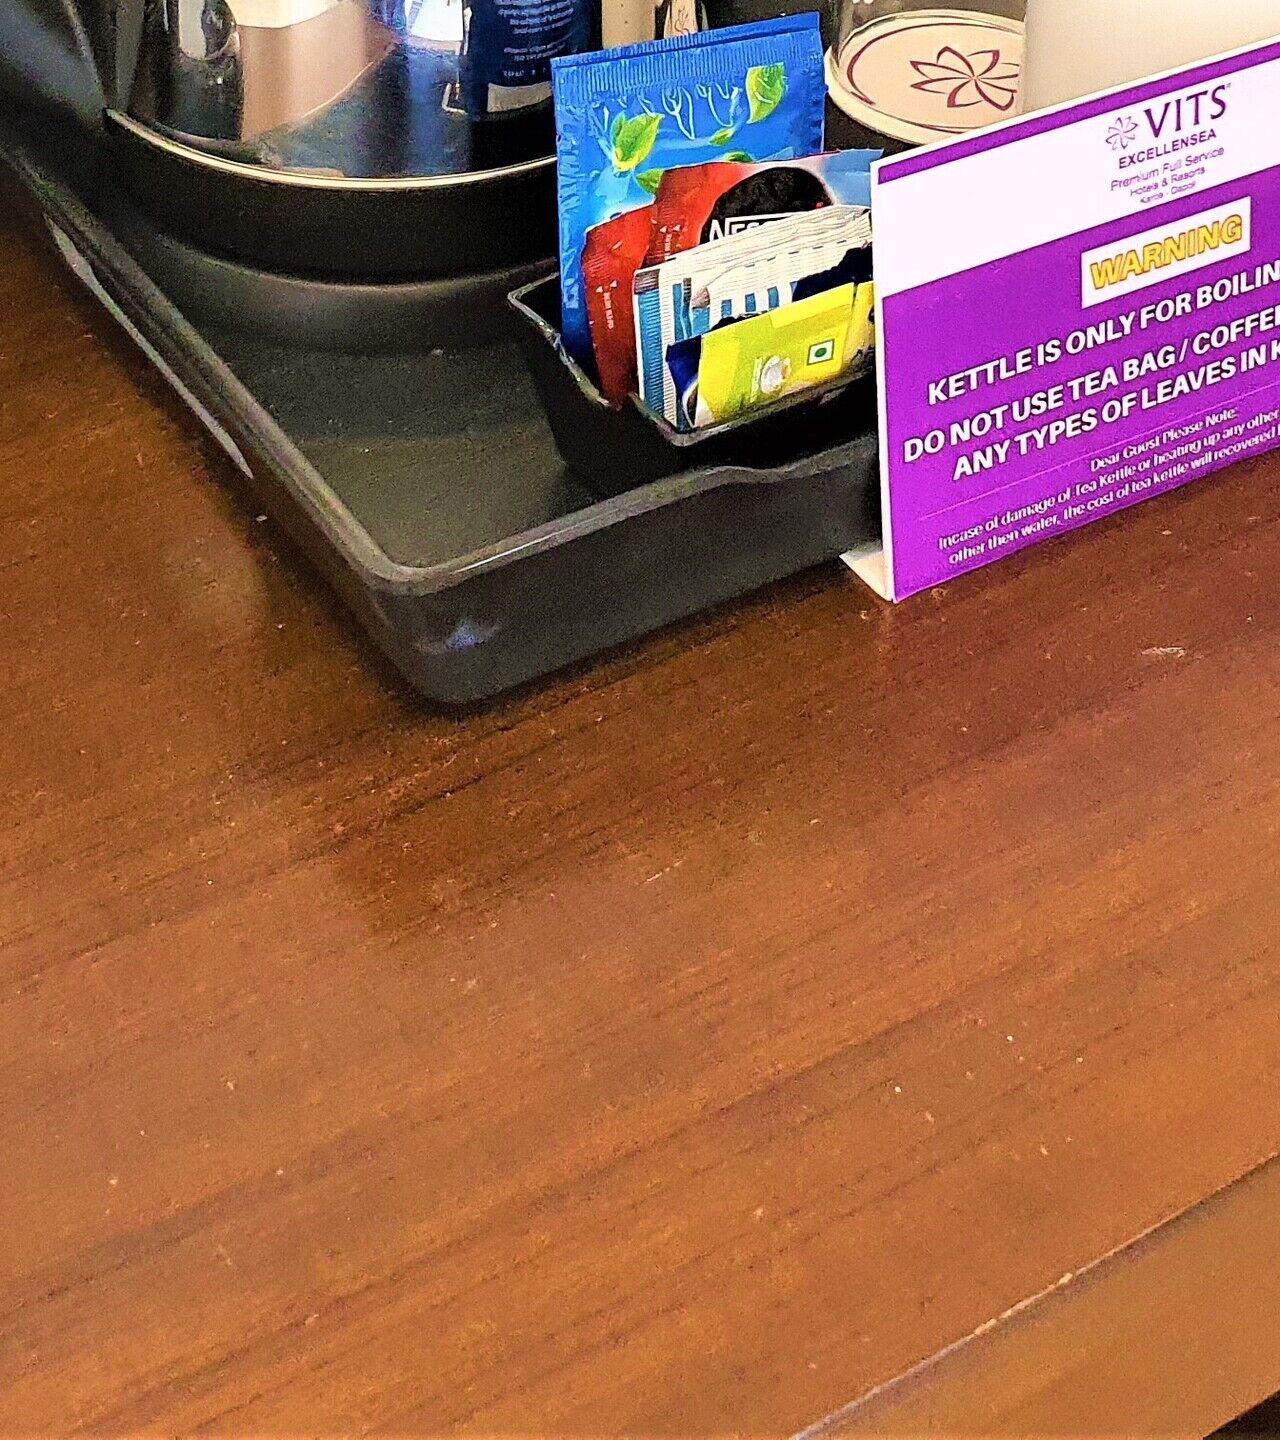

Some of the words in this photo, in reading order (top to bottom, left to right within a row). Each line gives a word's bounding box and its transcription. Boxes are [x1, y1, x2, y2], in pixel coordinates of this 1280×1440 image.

[1118, 128, 1217, 169] EXCELLENSEA
[1143, 84, 1227, 139] VITS
[1110, 168, 1160, 191] Premium
[1162, 159, 1183, 174] Full
[1185, 147, 1225, 167] Service
[1090, 213, 1243, 291] WARNING
[927, 348, 1033, 406] KETTLE
[1036, 339, 1062, 366] IS
[1065, 311, 1136, 356] ONLY
[1139, 292, 1192, 329] FOR
[902, 429, 945, 464] DO
[949, 404, 1010, 447] NOT
[1011, 384, 1065, 423] USE
[1067, 367, 1119, 401] TEA
[1122, 345, 1176, 382] BAG
[1178, 338, 1189, 362] /
[952, 439, 1011, 481] ANY
[1013, 408, 1098, 456] TYPES
[1101, 392, 1138, 423] OF
[1141, 357, 1237, 409] LEAVES
[1240, 343, 1268, 373] IN
[1090, 453, 1120, 473] Dear
[1122, 435, 1161, 459] Guest
[1162, 420, 1204, 444] Please
[938, 524, 983, 550] Incase
[985, 514, 999, 532] of
[1000, 496, 1056, 526] damage
[1057, 487, 1071, 505] of
[1075, 478, 1097, 496] Tea
[1098, 465, 1136, 488] Kettle
[1137, 459, 1152, 471] or
[1153, 437, 1202, 470] heating
[1203, 434, 1221, 452] up
[1222, 421, 1246, 441] any
[1246, 410, 1279, 431] other
[948, 543, 986, 565] other
[987, 529, 1020, 551] then
[1063, 504, 1085, 521] the
[1086, 489, 1114, 511] cost
[1116, 481, 1130, 499] of
[1131, 474, 1152, 494] tea
[1152, 461, 1190, 486] kettle
[1190, 449, 1213, 470] will
[1213, 426, 1276, 460] recovered
